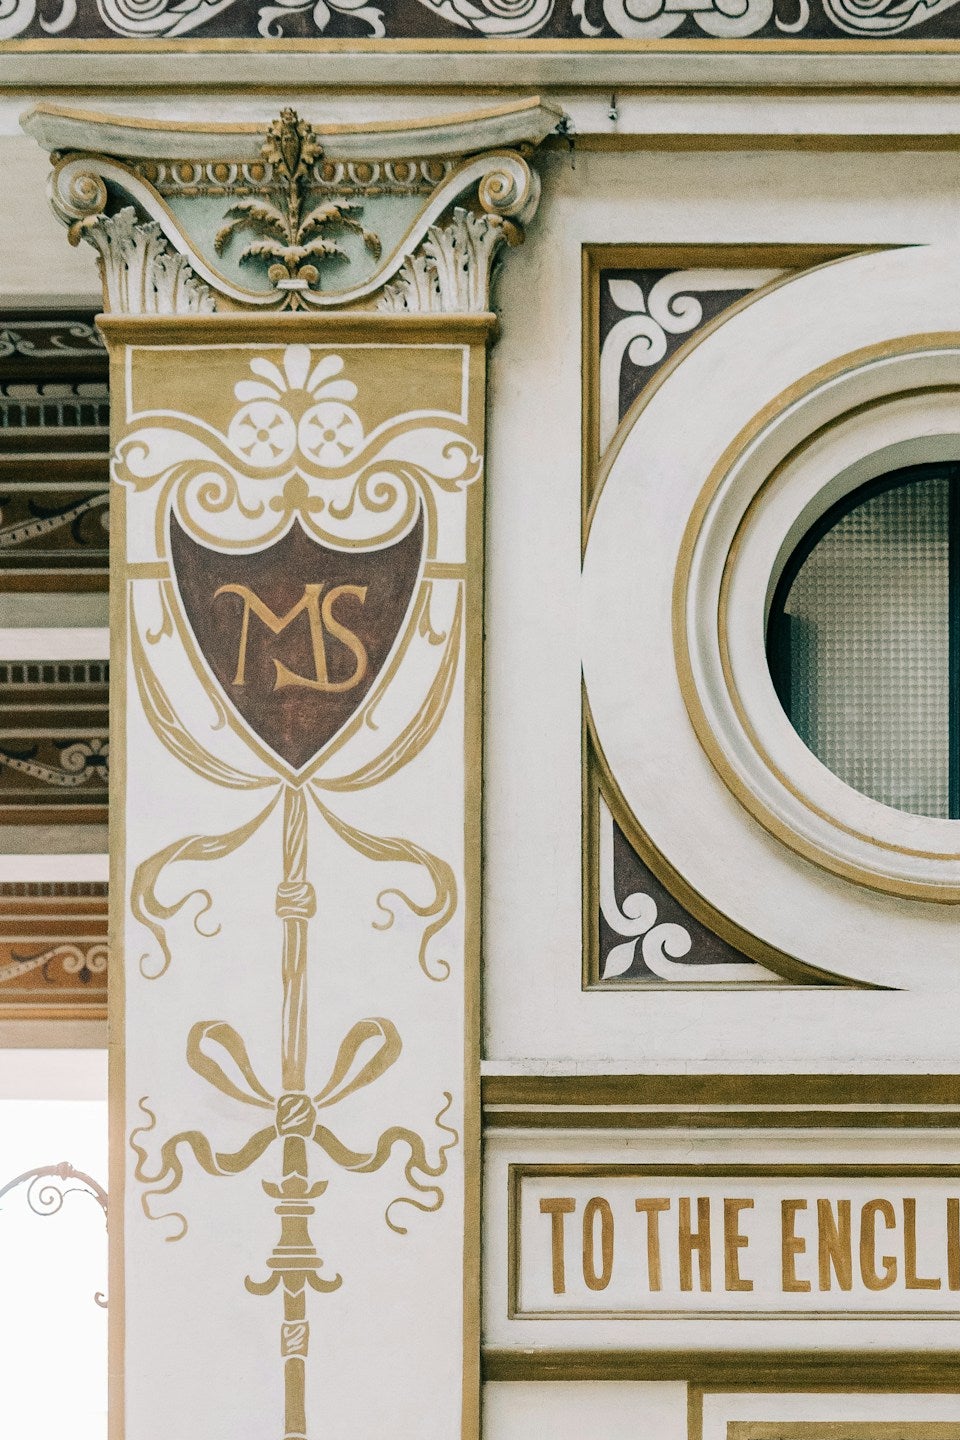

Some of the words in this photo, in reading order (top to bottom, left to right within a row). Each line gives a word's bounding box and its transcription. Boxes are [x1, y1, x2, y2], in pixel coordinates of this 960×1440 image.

[213, 583, 368, 692] MS
[540, 1197, 613, 1293] TO
[636, 1197, 754, 1292] THE
